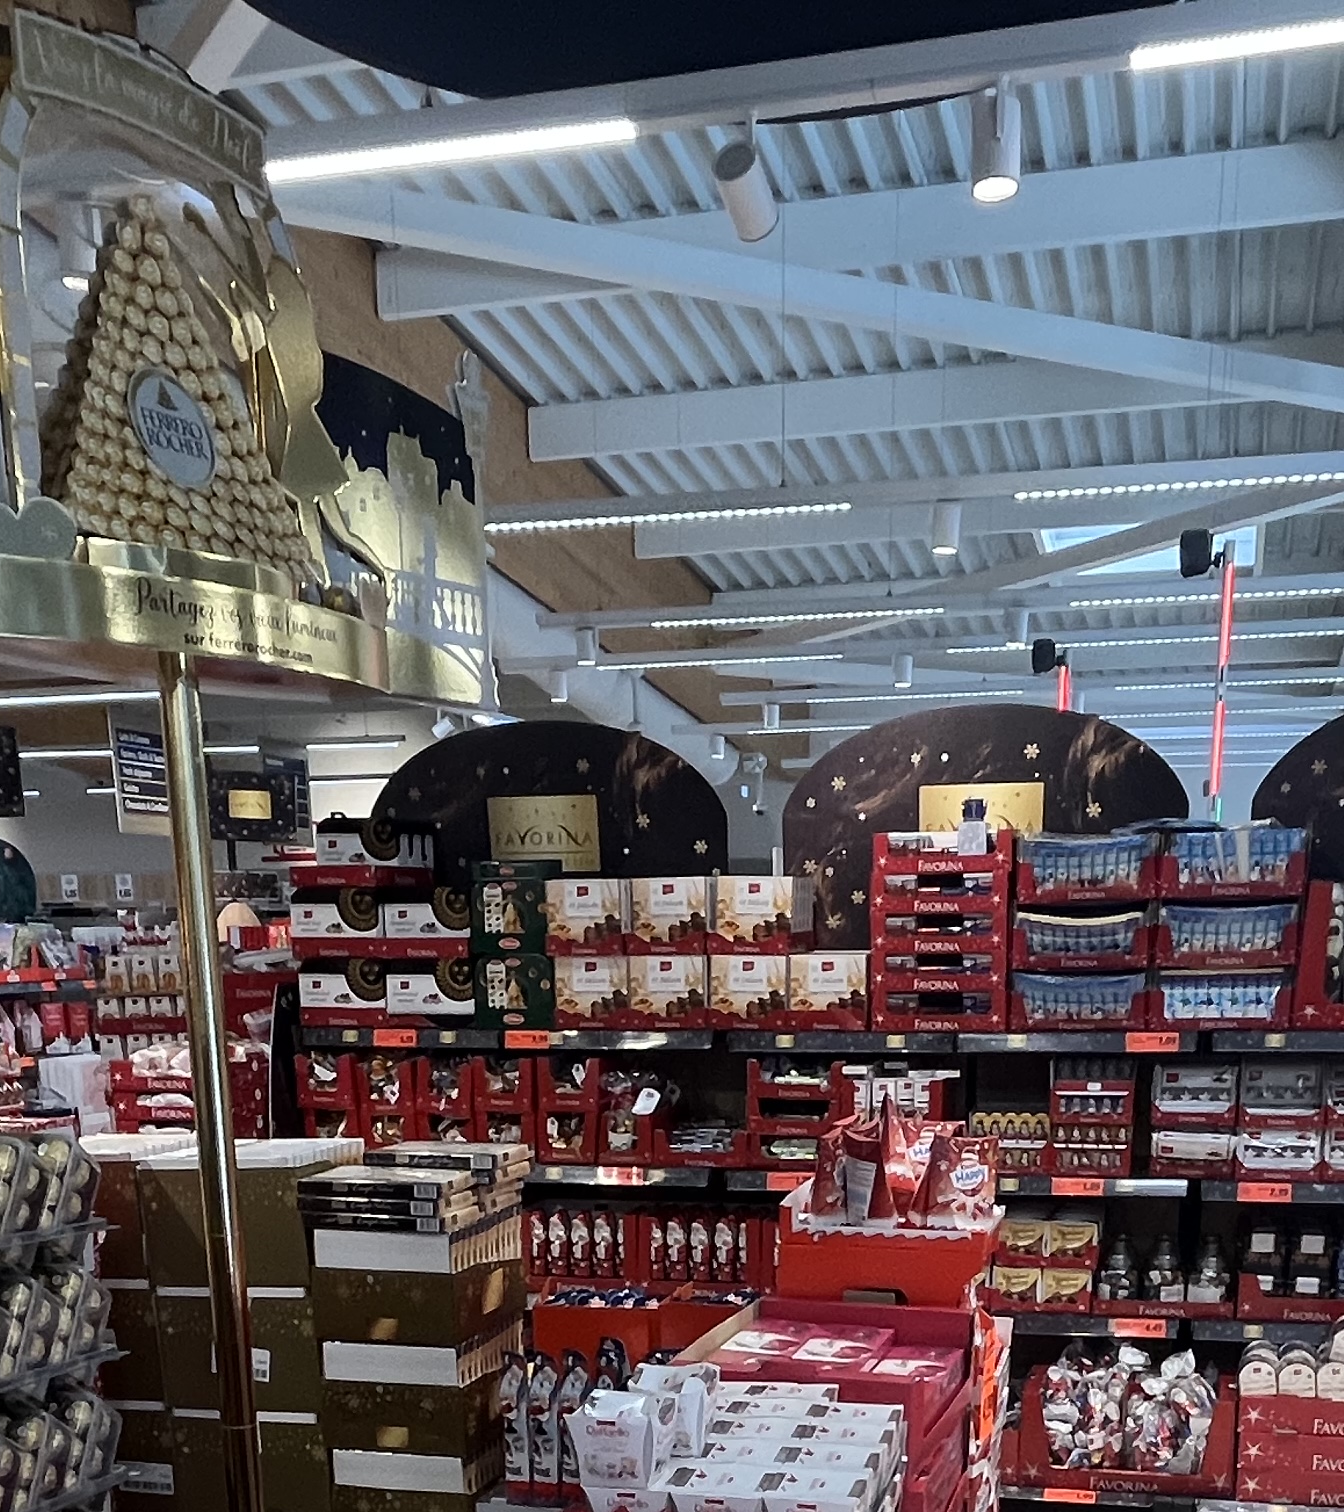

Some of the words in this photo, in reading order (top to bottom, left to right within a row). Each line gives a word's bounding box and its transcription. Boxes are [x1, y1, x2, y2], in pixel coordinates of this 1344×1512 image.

[140, 406, 203, 440] FERRERO
[145, 426, 209, 460] ROCHER
[135, 576, 216, 629] Partagez
[184, 632, 206, 647] sur
[495, 824, 593, 848] FAVORINA
[1089, 1476, 1159, 1493] FAVORINA
